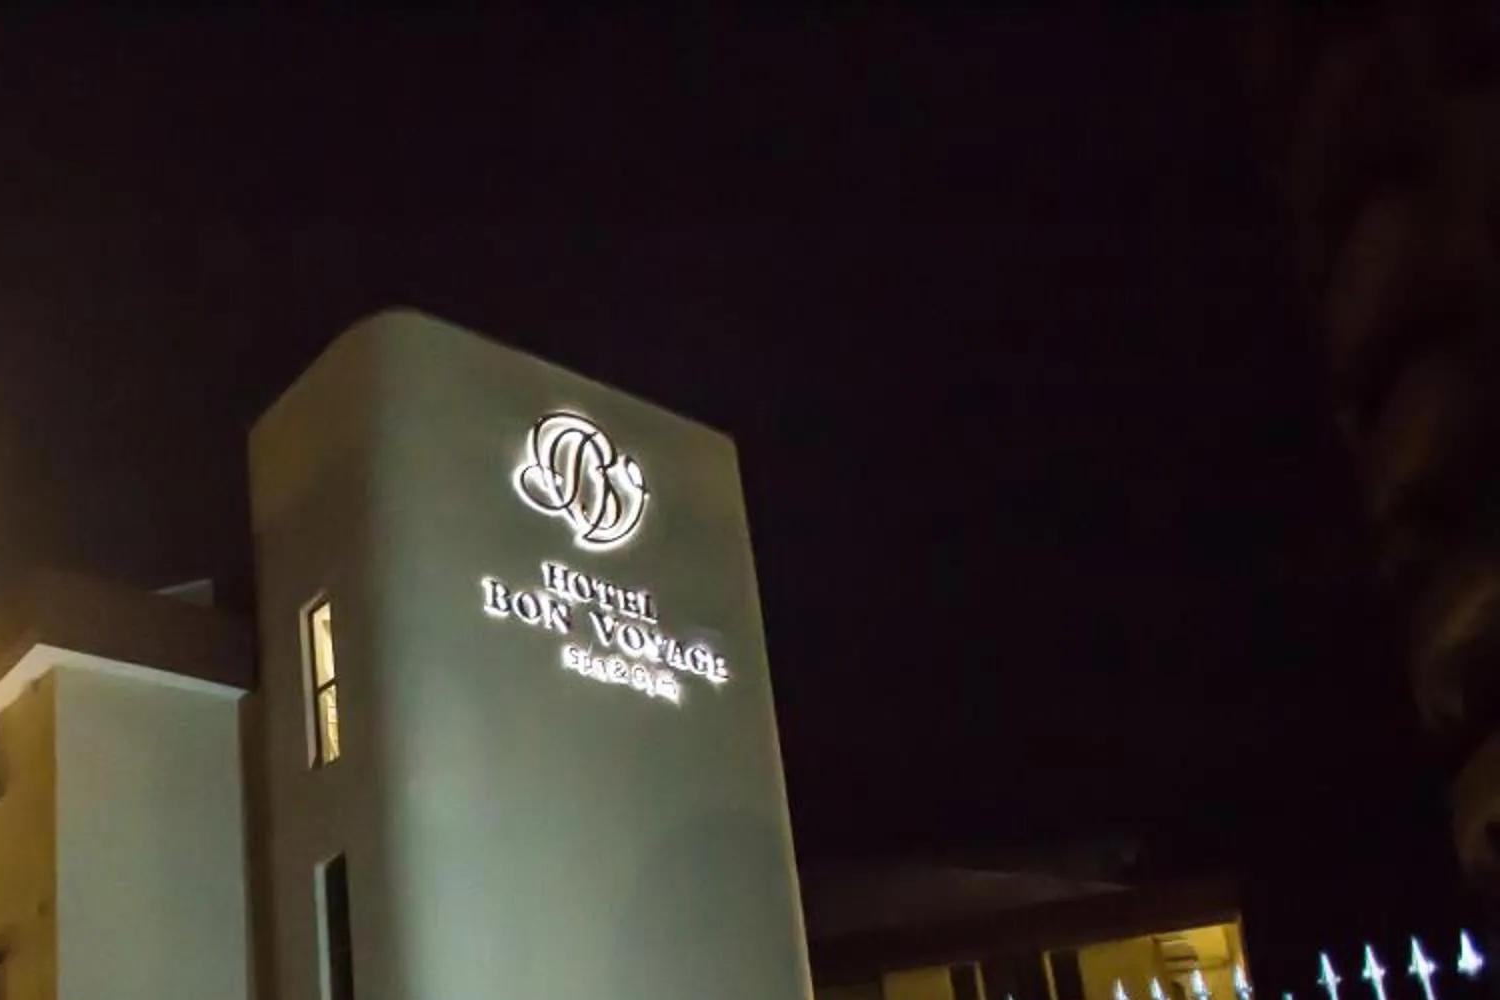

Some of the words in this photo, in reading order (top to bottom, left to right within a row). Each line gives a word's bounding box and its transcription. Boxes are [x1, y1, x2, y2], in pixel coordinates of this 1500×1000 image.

[481, 576, 573, 635] BON
[589, 610, 730, 683] VOYAGE
[541, 560, 658, 625] HOTEL
